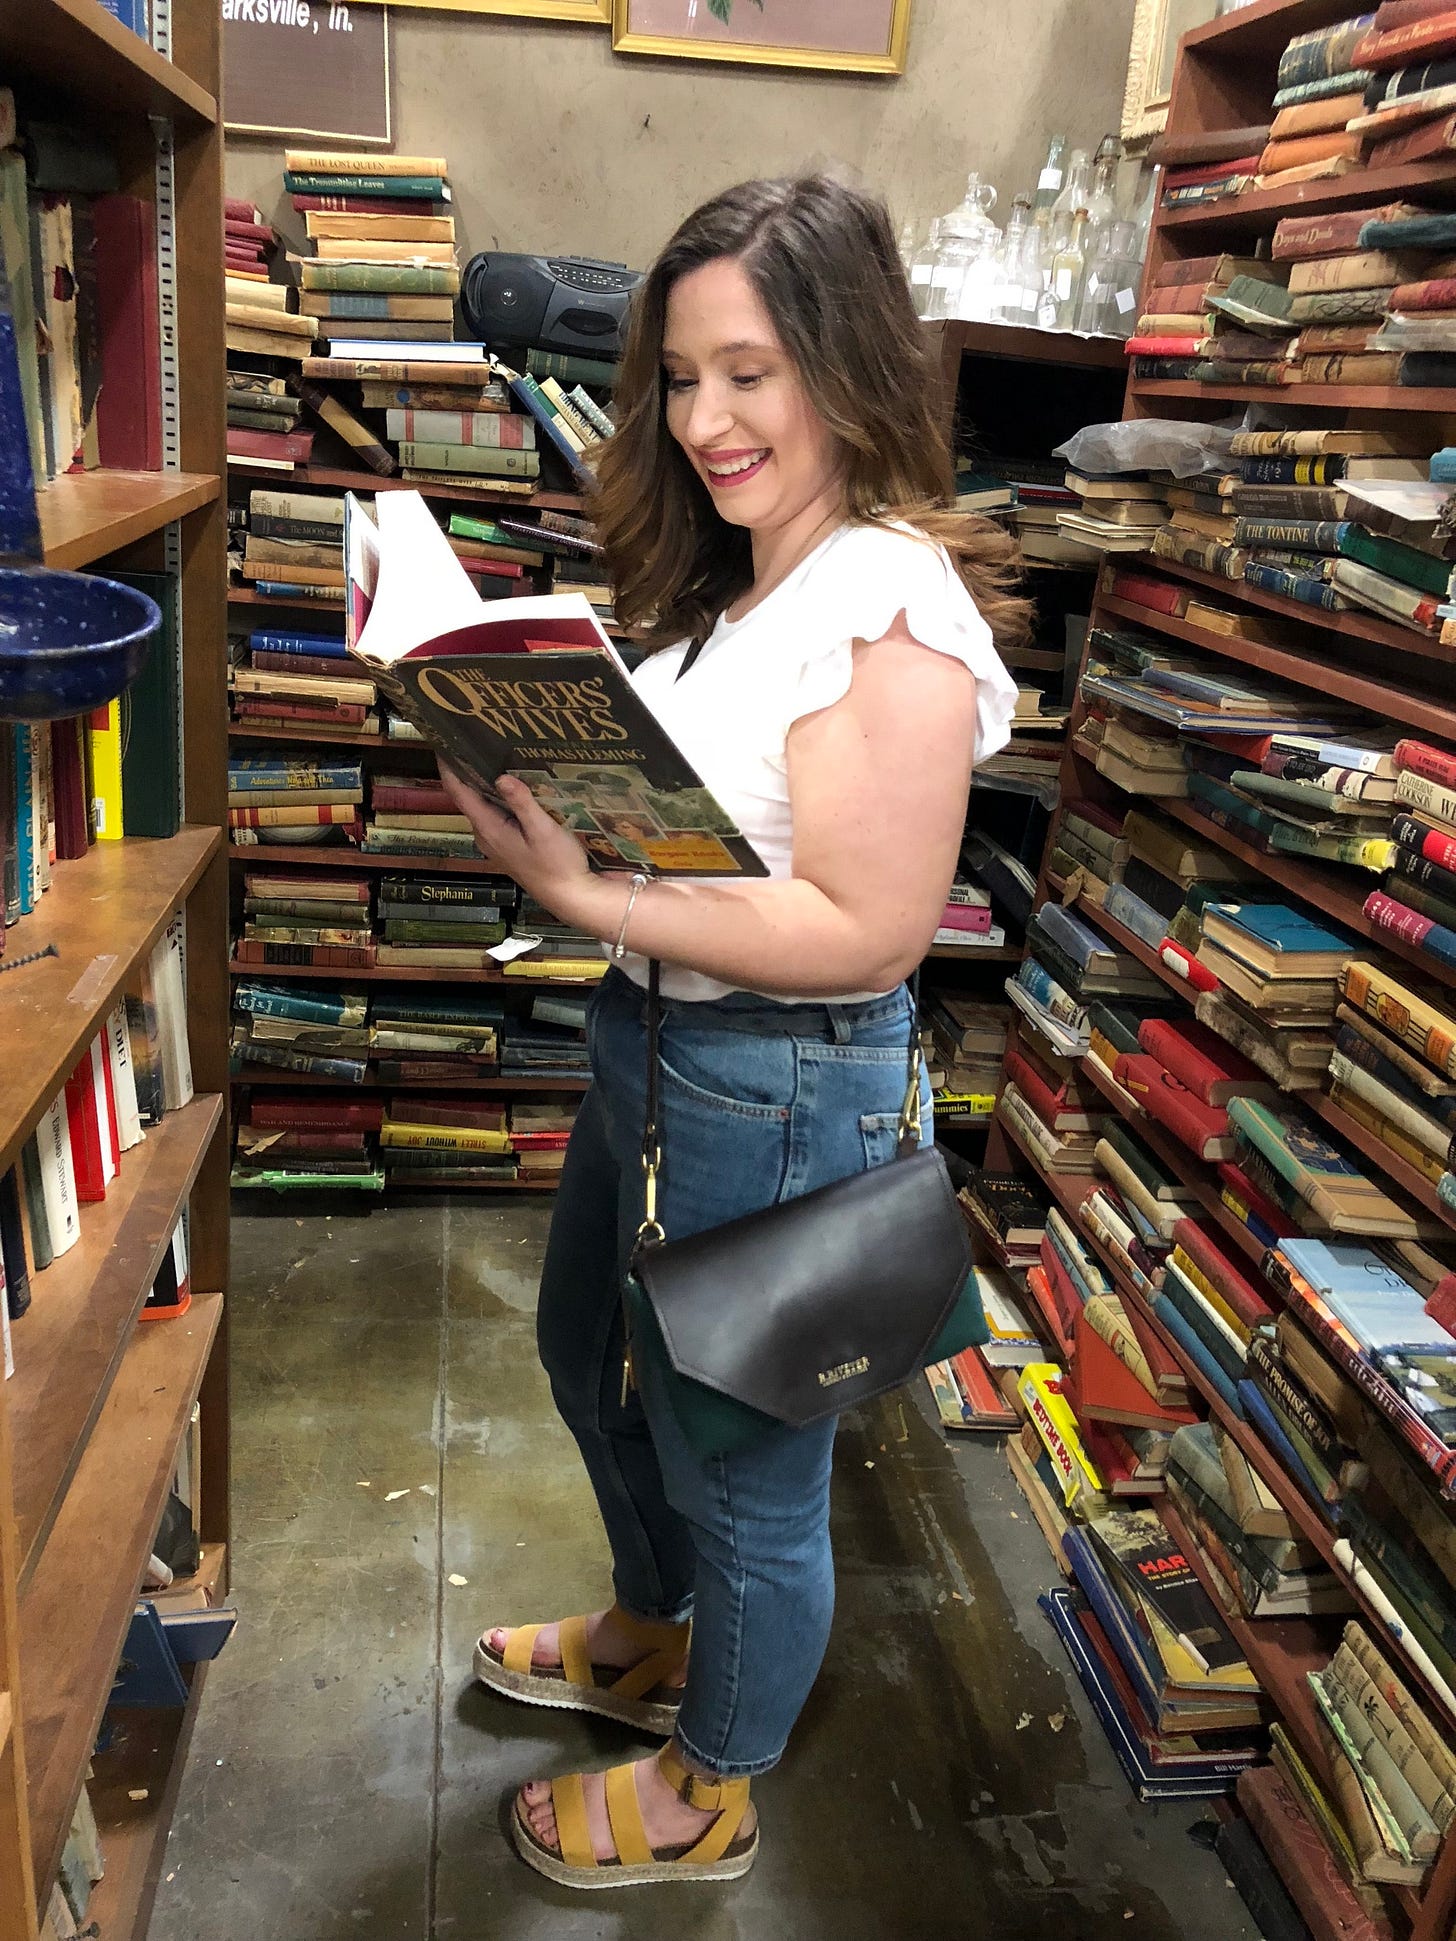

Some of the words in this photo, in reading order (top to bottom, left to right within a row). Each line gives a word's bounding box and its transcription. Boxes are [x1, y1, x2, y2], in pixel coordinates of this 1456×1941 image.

[221, 0, 318, 34] arksville,
[330, 158, 350, 169] LOST
[352, 160, 385, 170] QUEEN
[303, 526, 326, 536] MOON
[1245, 524, 1264, 539] THE
[1267, 525, 1311, 542] TONTINE
[452, 669, 491, 682] THE
[472, 706, 629, 741] WIVES
[512, 748, 578, 761] THOMAS
[578, 748, 648, 761] FLEMING
[1401, 771, 1434, 796] CATHERINE
[1399, 783, 1432, 809] COOKSON
[421, 885, 473, 902] Stephania
[115, 1027, 127, 1068] DIET
[933, 1103, 969, 1114] ummies
[50, 1116, 62, 1160] EDWARD
[407, 1135, 423, 1146] JOY
[424, 1136, 457, 1147] WITHOUT
[460, 1138, 487, 1150] STREET
[55, 1158, 68, 1205] STEWART
[1255, 1348, 1272, 1372] THE
[1270, 1366, 1307, 1418] PROMISE
[1303, 1411, 1318, 1431] OF
[1032, 1397, 1060, 1448] BEDTIME
[1056, 1441, 1073, 1478] BOOK
